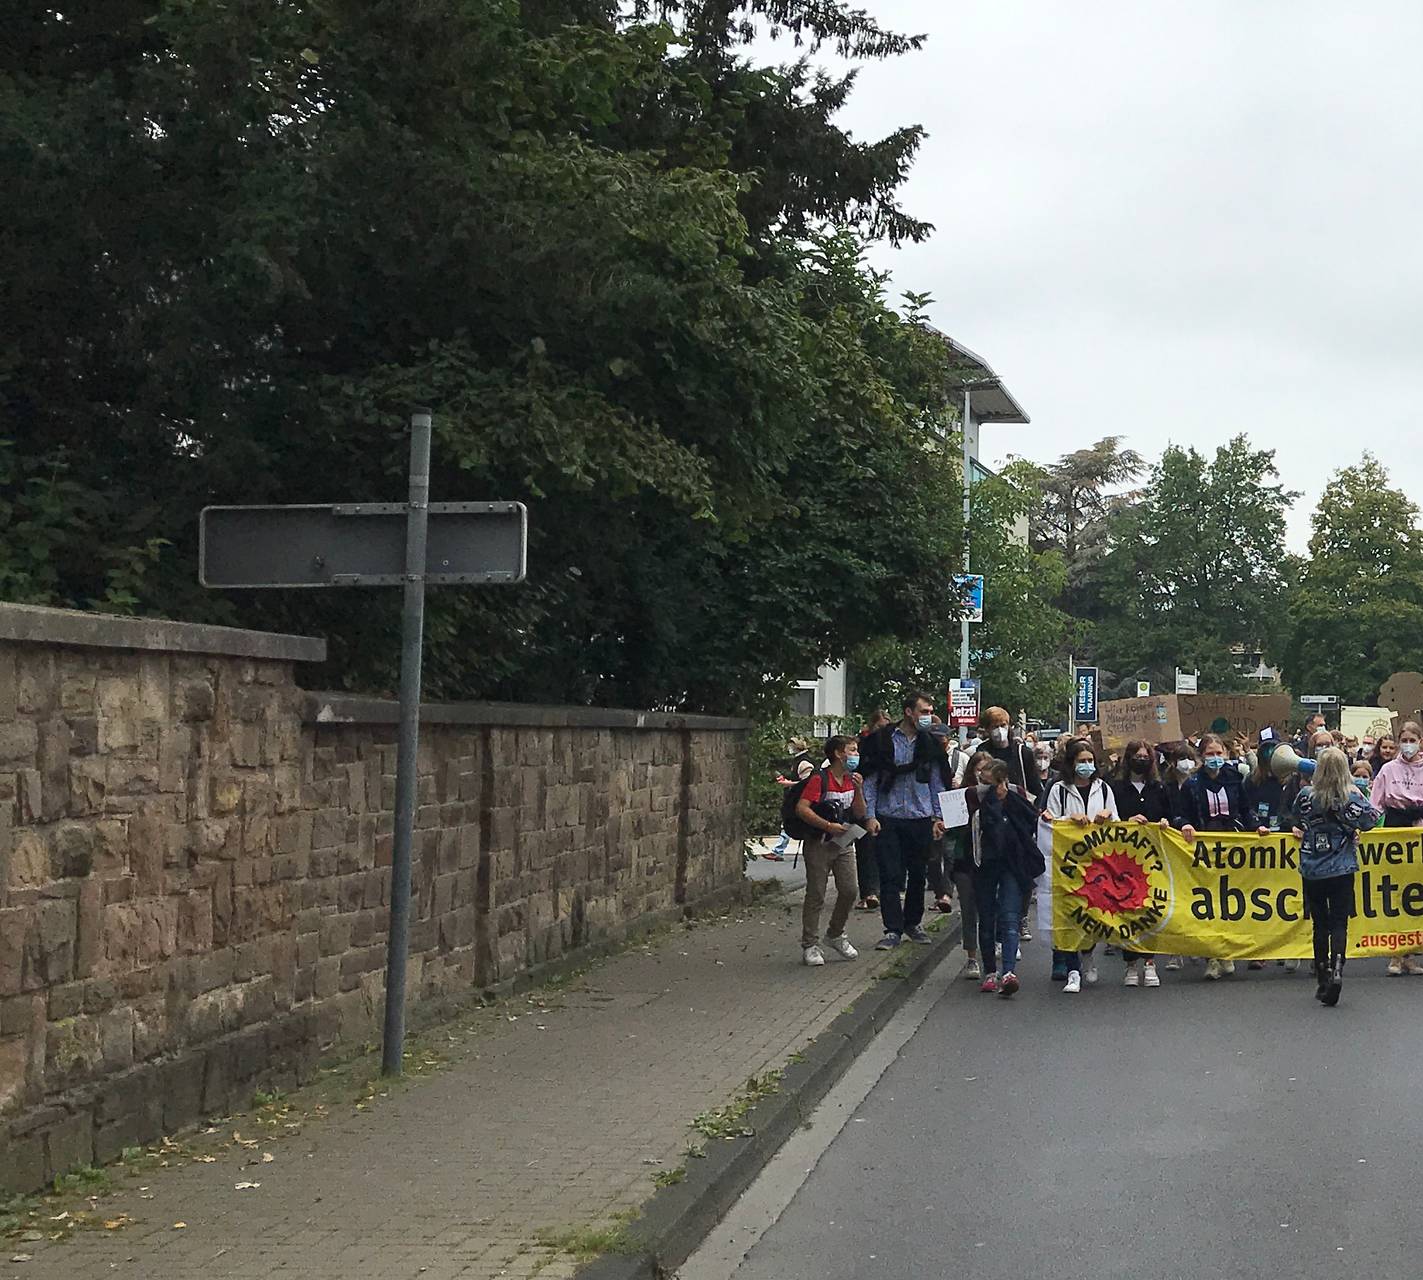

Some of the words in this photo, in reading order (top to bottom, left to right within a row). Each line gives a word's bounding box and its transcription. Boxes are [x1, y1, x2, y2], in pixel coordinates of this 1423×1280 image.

[951, 707, 977, 717] Jetzt!
[1060, 826, 1163, 879] ATOMKRAFT?
[1070, 906, 1114, 939] NEIN
[1119, 887, 1167, 939] DANKE
